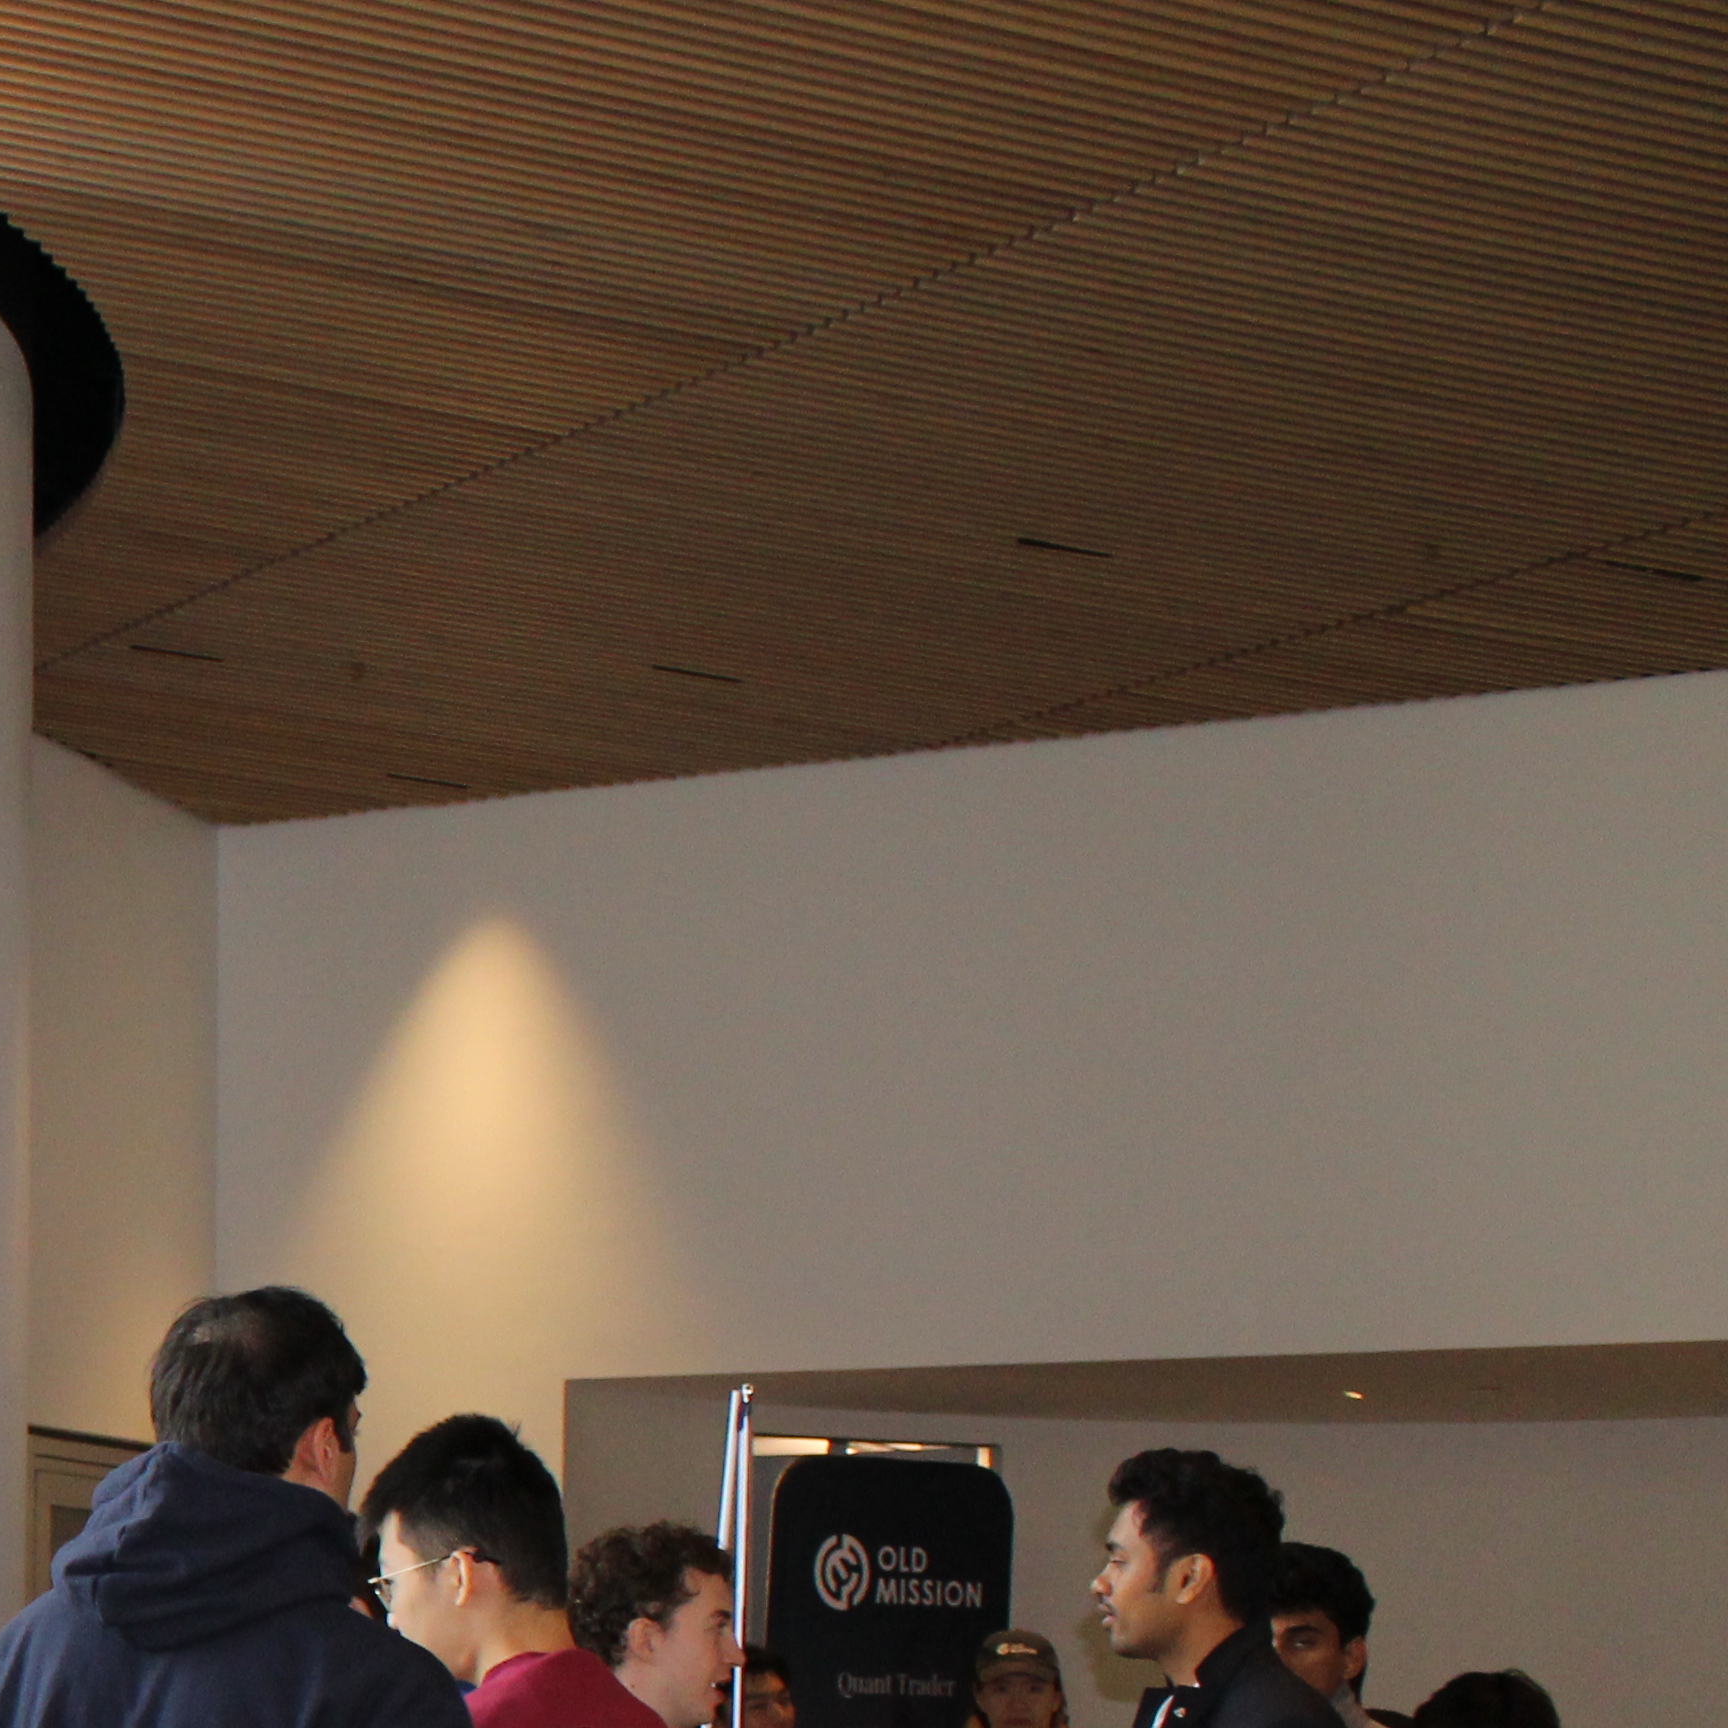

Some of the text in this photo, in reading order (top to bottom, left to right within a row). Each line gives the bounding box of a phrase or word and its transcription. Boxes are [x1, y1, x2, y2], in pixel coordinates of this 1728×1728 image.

[877, 1545, 928, 1573] OLD
[875, 1577, 983, 1608] MISSION
[838, 1671, 957, 1699] Quant Trader
